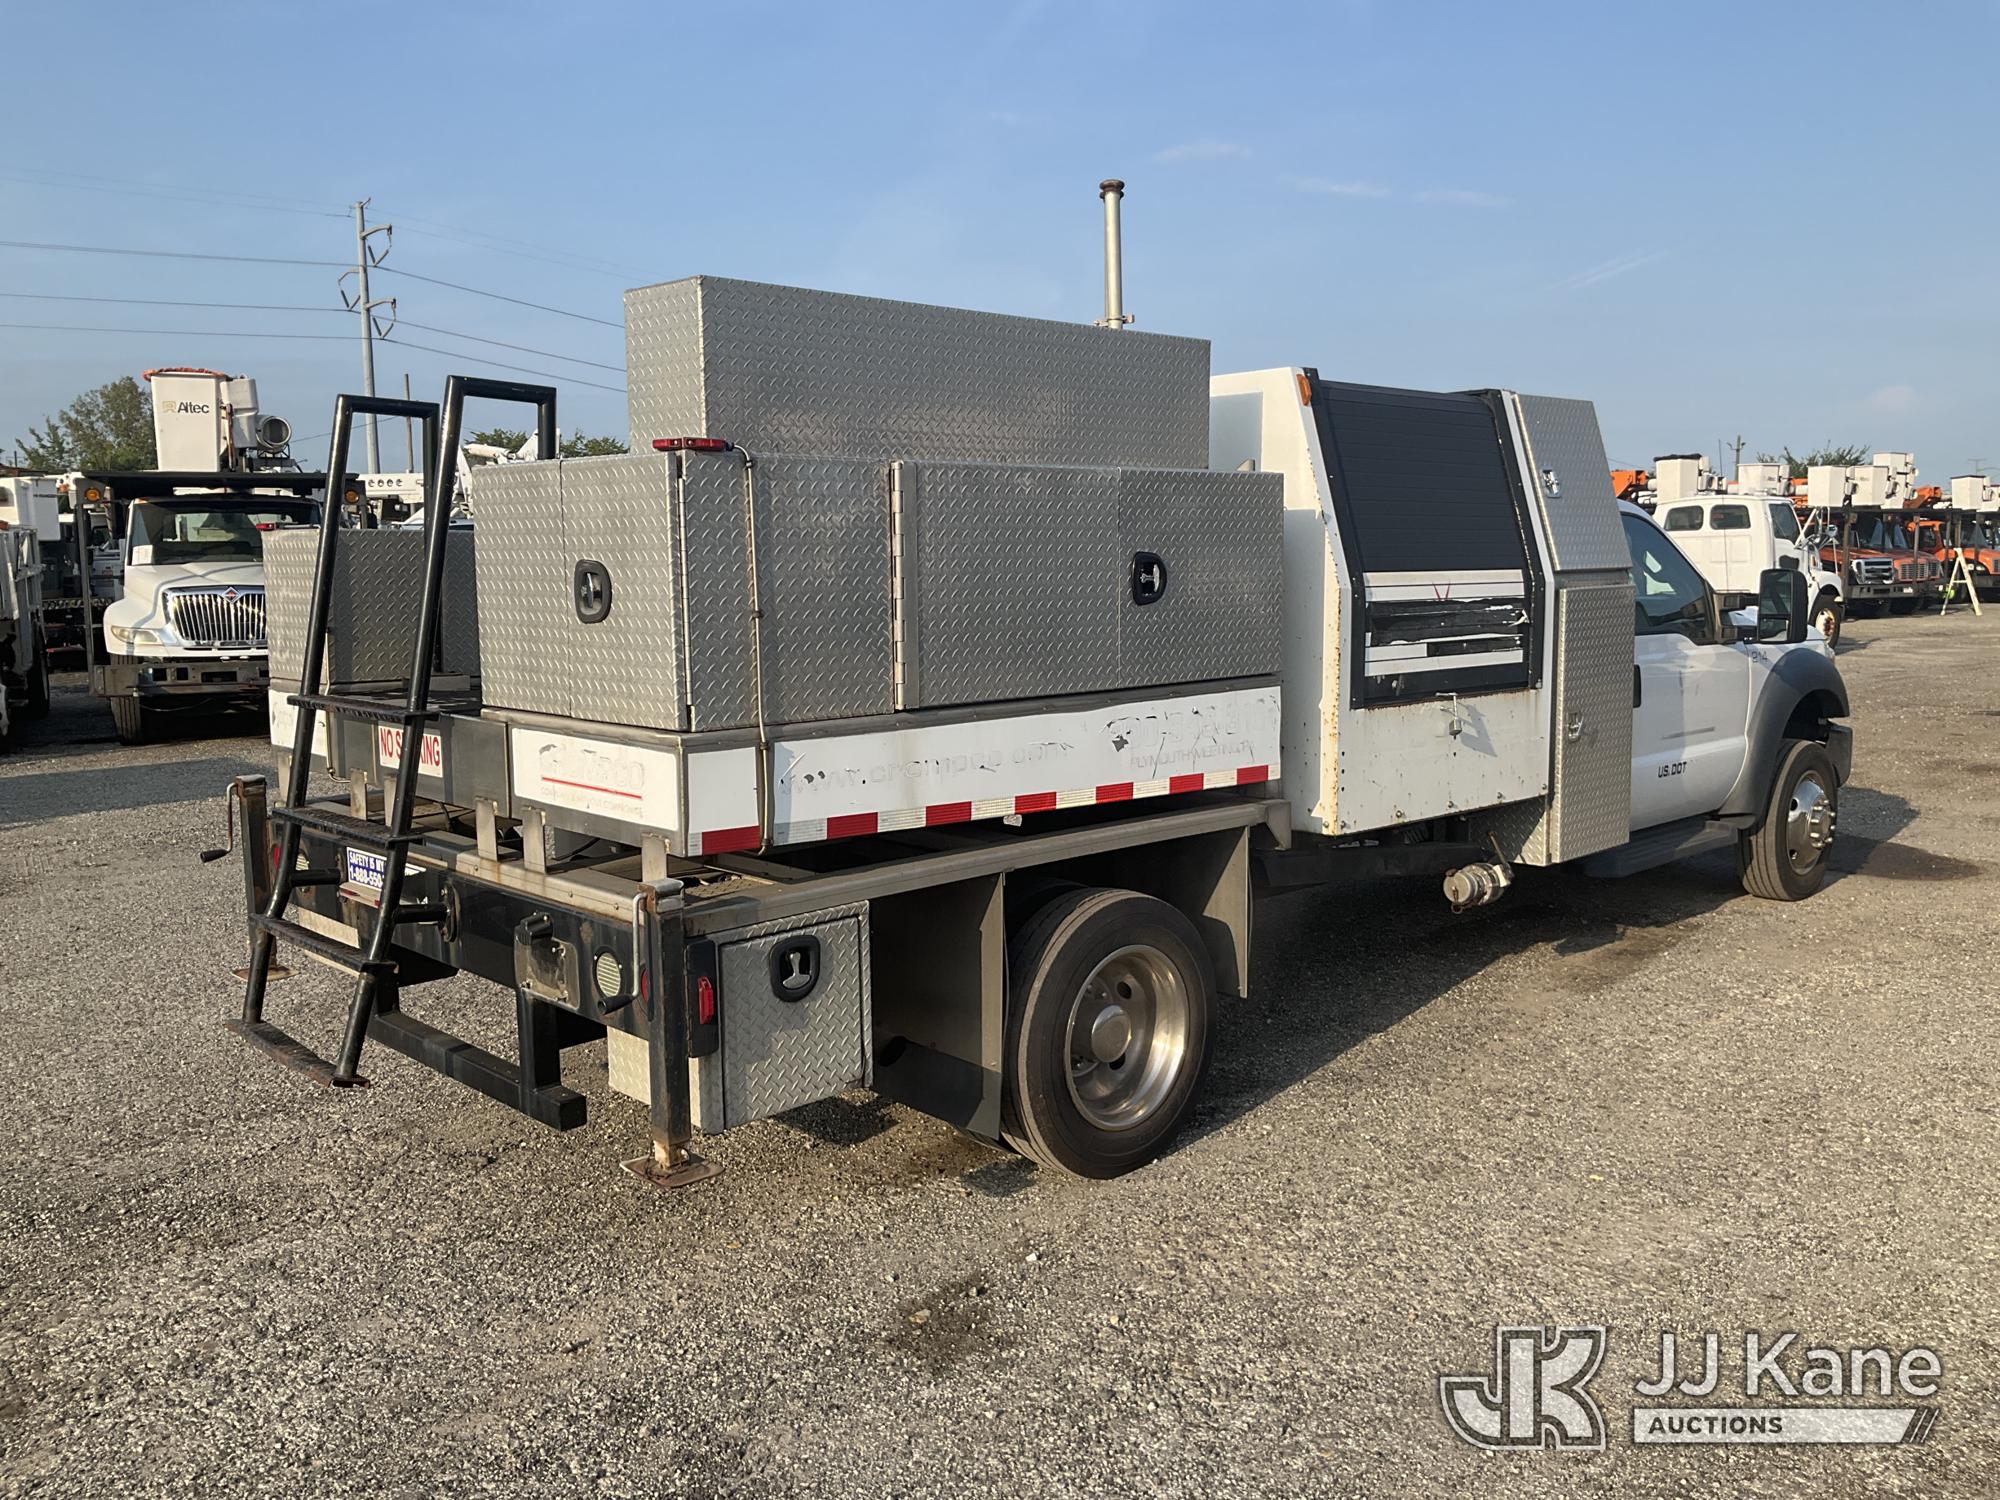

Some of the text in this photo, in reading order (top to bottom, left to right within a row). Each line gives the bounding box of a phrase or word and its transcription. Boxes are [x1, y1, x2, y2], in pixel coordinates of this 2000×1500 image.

[177, 401, 210, 414] Altec
[380, 727, 441, 767] NO SING
[1671, 761, 1687, 776] DOT
[349, 851, 369, 868] SAFETY
[369, 857, 376, 870] IS
